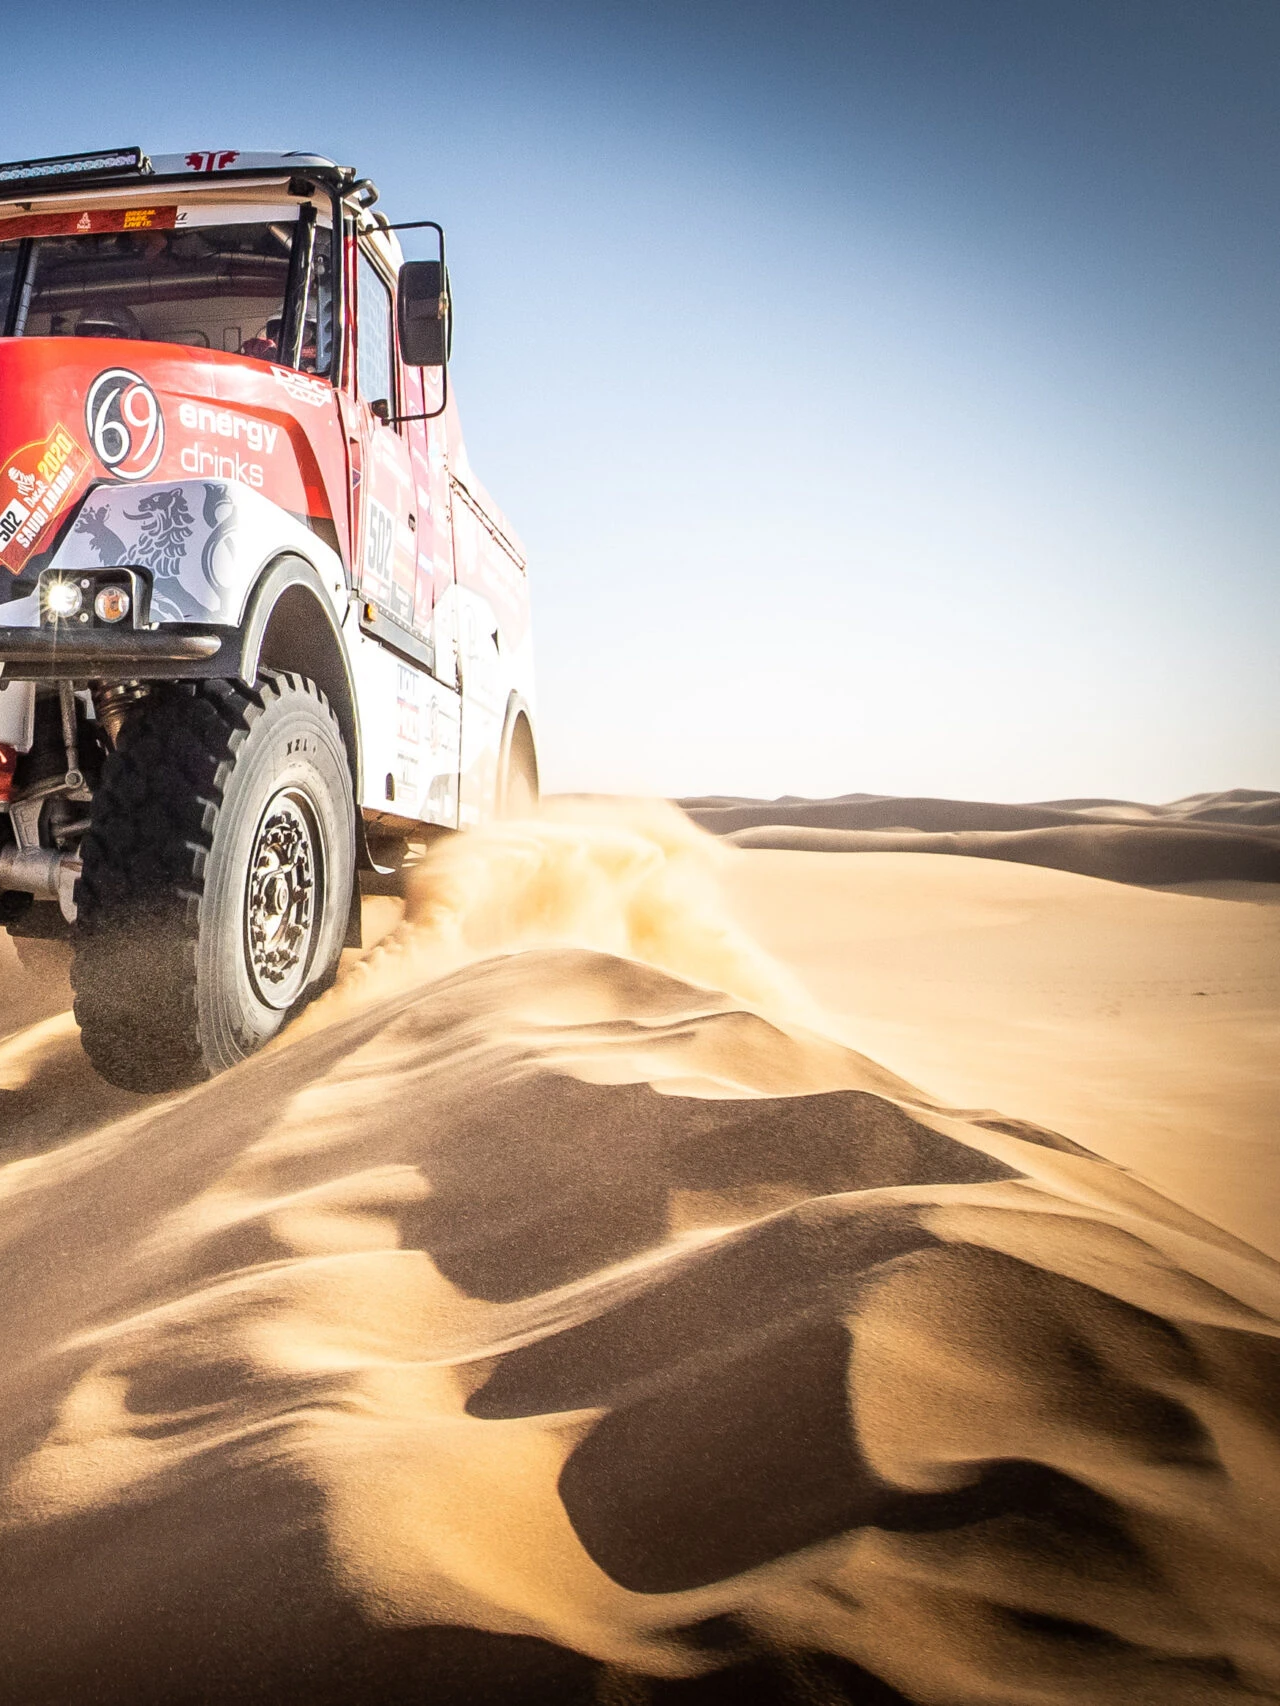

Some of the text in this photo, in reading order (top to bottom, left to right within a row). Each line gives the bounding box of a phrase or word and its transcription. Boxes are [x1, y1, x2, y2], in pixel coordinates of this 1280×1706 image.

[93, 382, 160, 467] 69
[179, 403, 278, 453] energy
[37, 432, 73, 483] 2020
[181, 442, 264, 487] drinks
[16, 464, 75, 548] SAUDI ARABIA
[367, 501, 393, 581] 502
